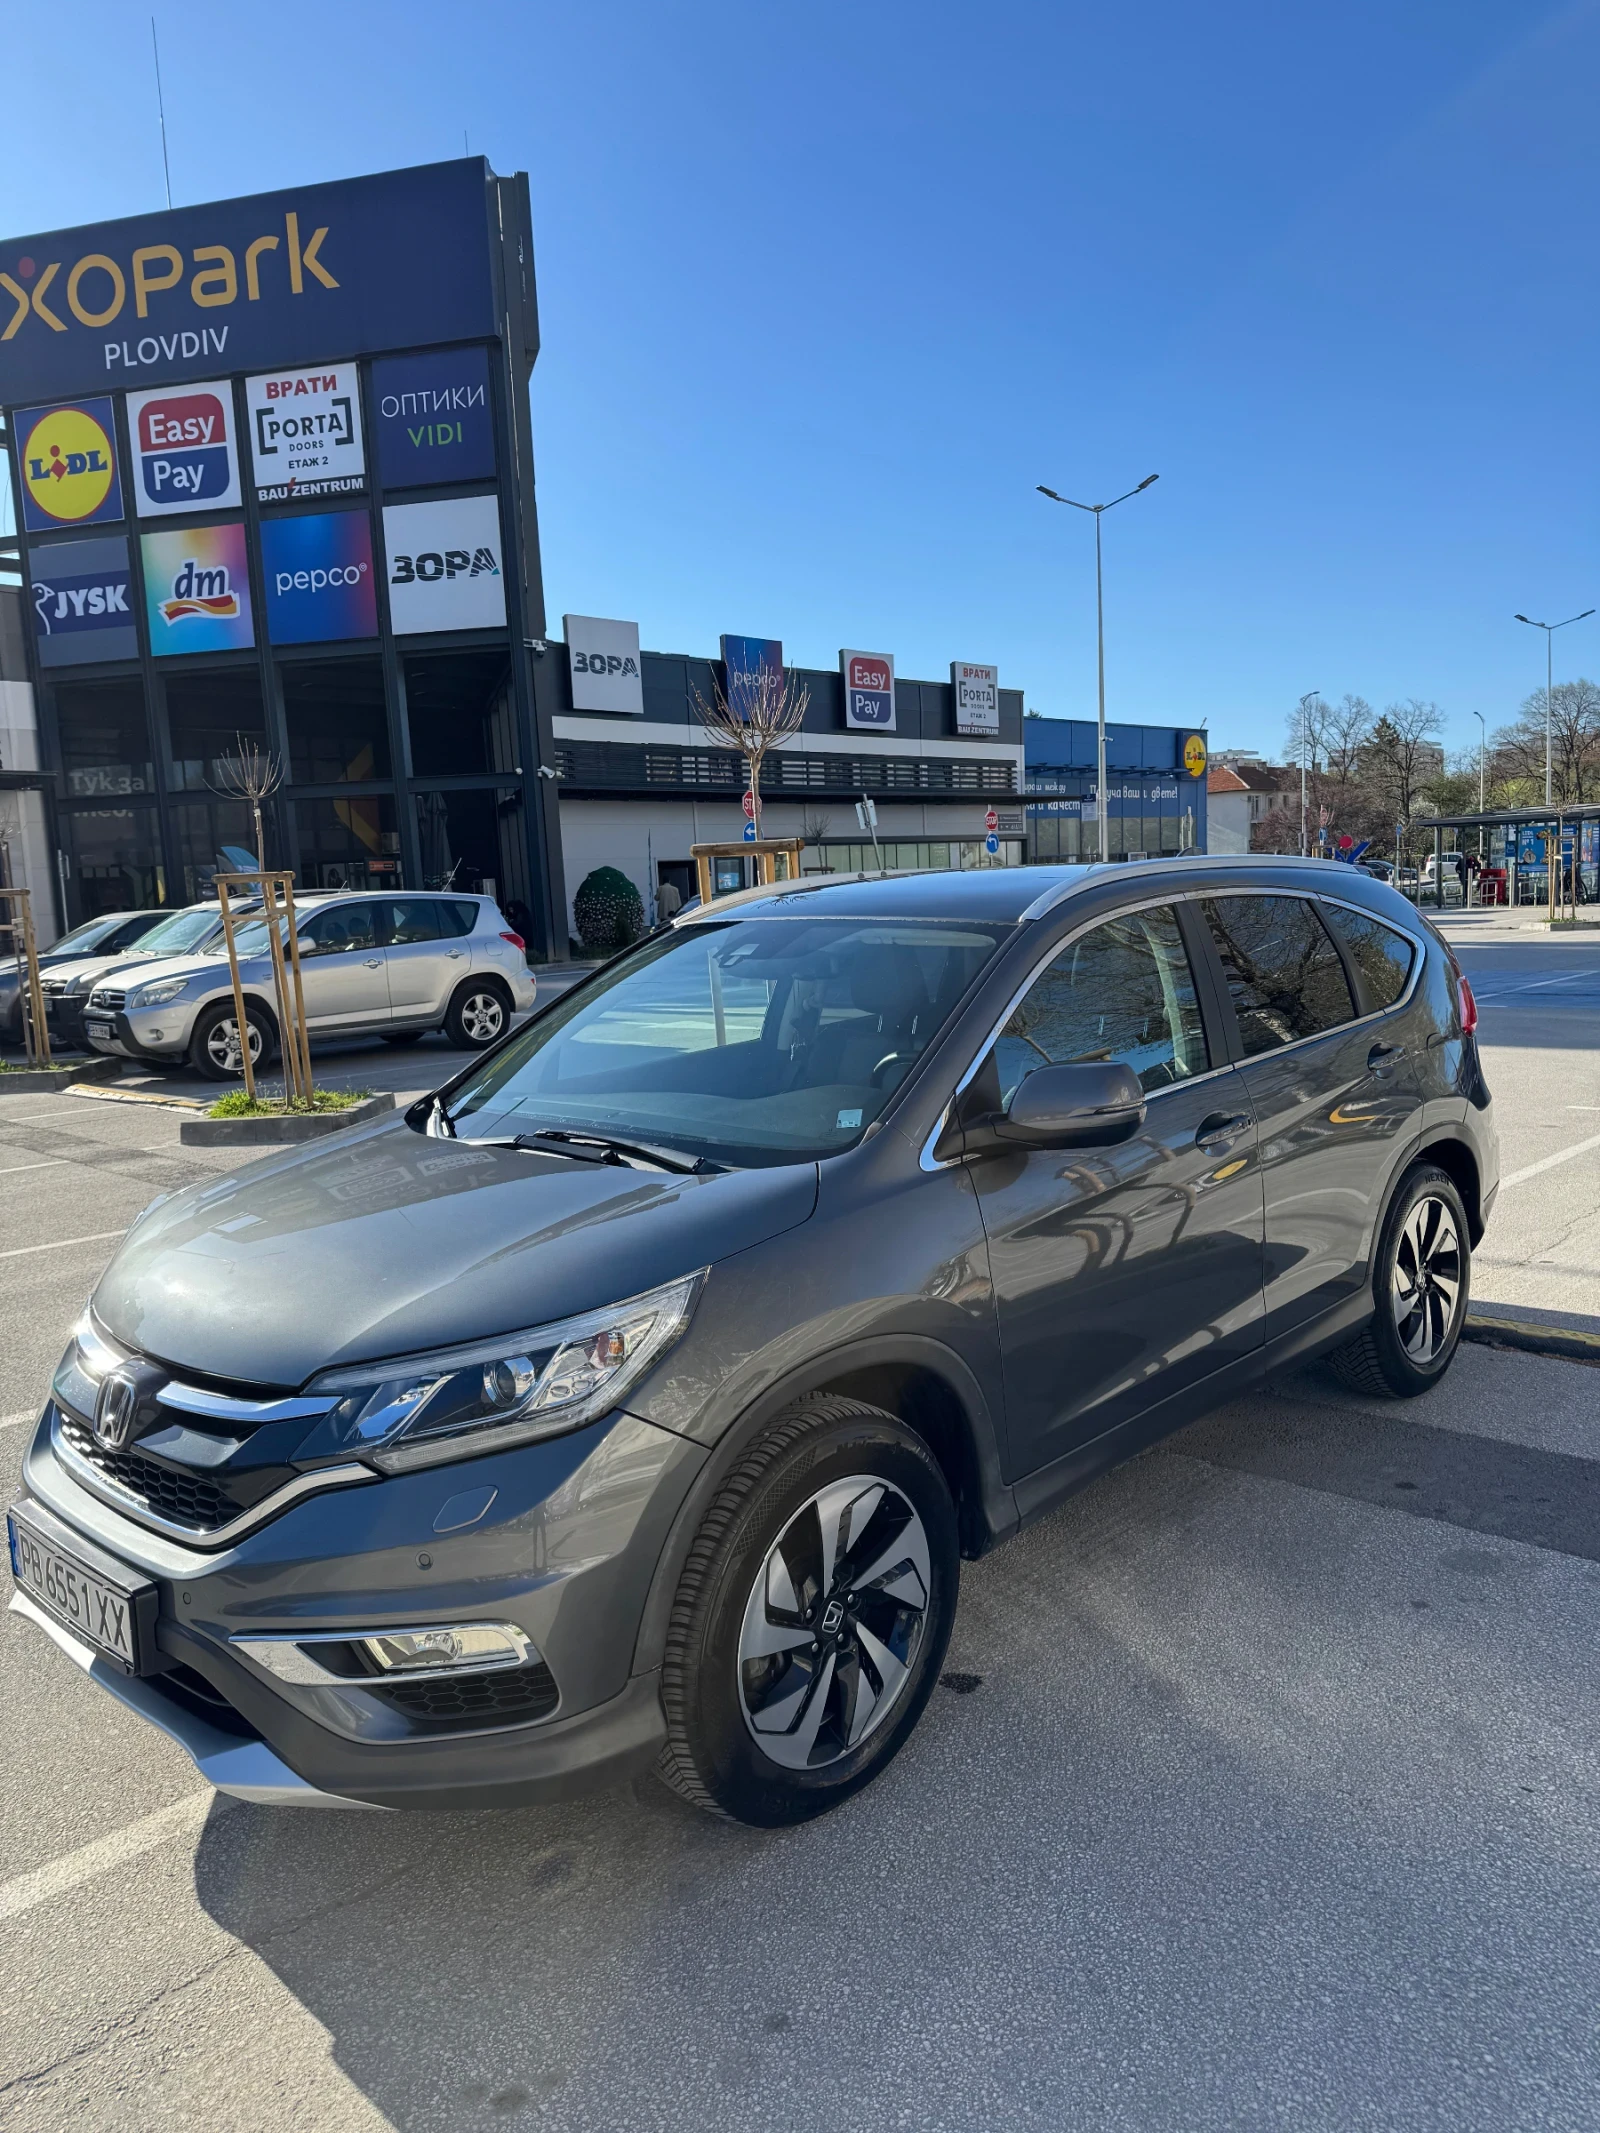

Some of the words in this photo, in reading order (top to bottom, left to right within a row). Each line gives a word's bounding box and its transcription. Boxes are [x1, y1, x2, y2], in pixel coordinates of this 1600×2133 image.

[104, 326, 229, 369] PLOVDIV
[266, 375, 337, 399] ВРАТИ
[382, 385, 485, 418] ОПТИКИ
[149, 413, 215, 445] Easy
[268, 413, 343, 440] PORTA
[407, 422, 463, 447] VIDI
[289, 440, 324, 452] DOORS
[288, 457, 319, 469] ЕТАЖ
[322, 456, 329, 465] 2
[153, 461, 204, 493] Pay
[391, 548, 500, 584] ЗОРА
[173, 561, 226, 600] dm
[54, 584, 129, 619] JYSK
[573, 652, 640, 678] ЗОРА
[963, 667, 991, 680] ВРАТИ
[854, 666, 886, 690] Easy
[855, 694, 880, 719] Pay
[963, 689, 992, 702] PORTA
[69, 771, 114, 795] Тук
[118, 777, 145, 795] за
[1045, 781, 1067, 794] между
[1151, 785, 1178, 802] двете!
[986, 816, 997, 826] STOP
[1424, 1172, 1450, 1186] NEXEN
